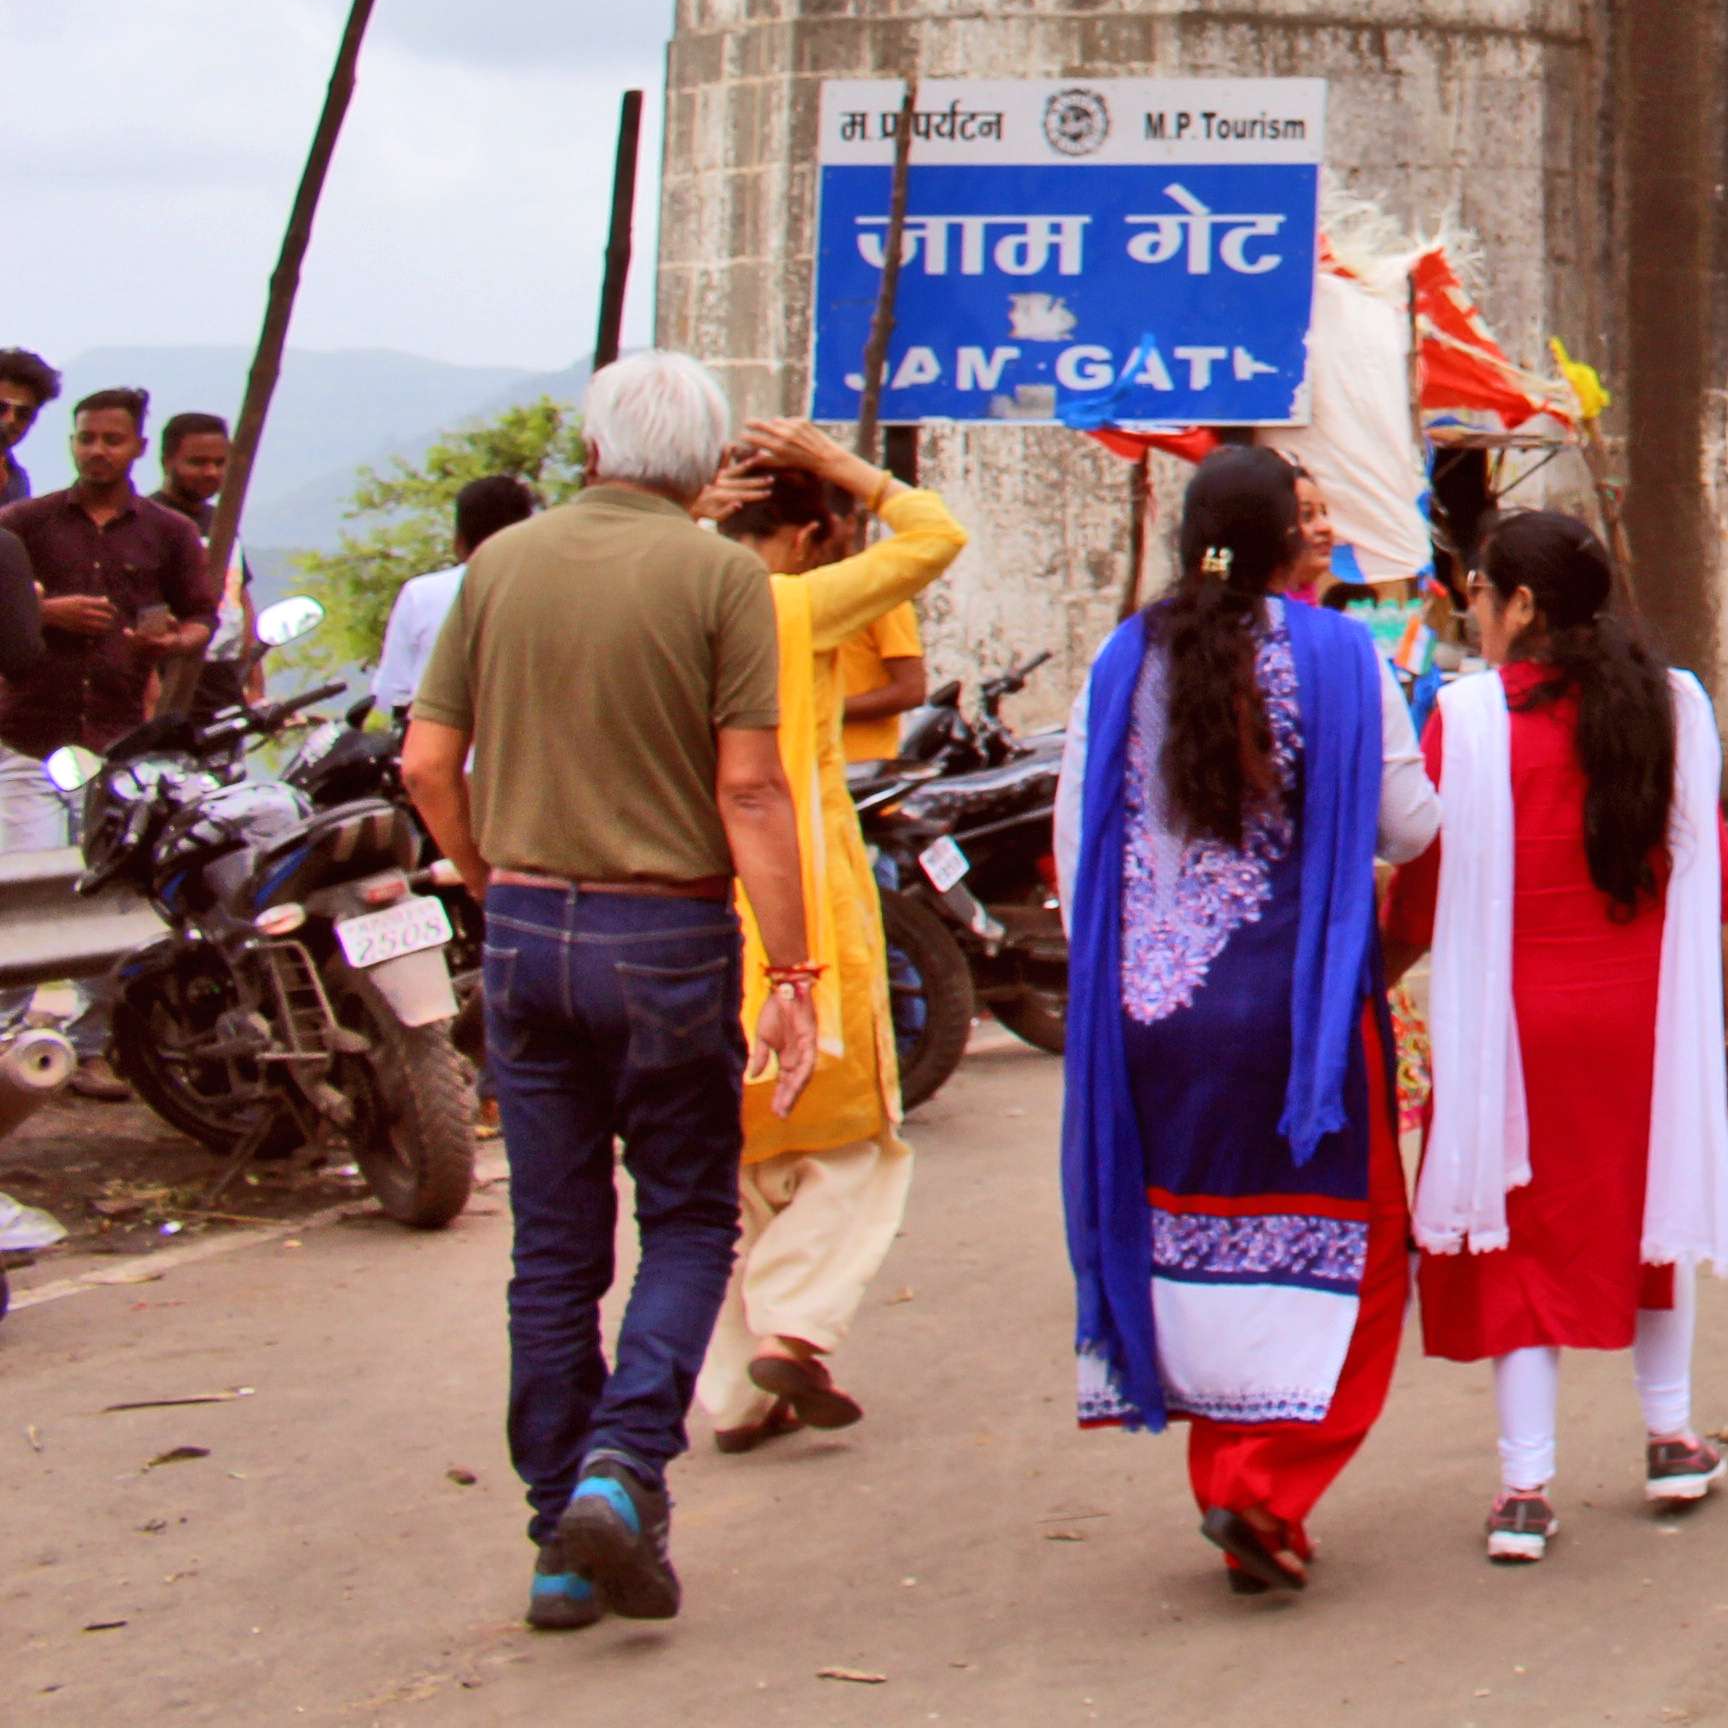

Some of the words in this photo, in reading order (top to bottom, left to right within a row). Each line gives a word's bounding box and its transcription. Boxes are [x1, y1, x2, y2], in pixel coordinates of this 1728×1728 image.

[1201, 112, 1306, 139] Tourism
[855, 215, 1092, 275] जाम
[1124, 183, 1286, 274] गेट
